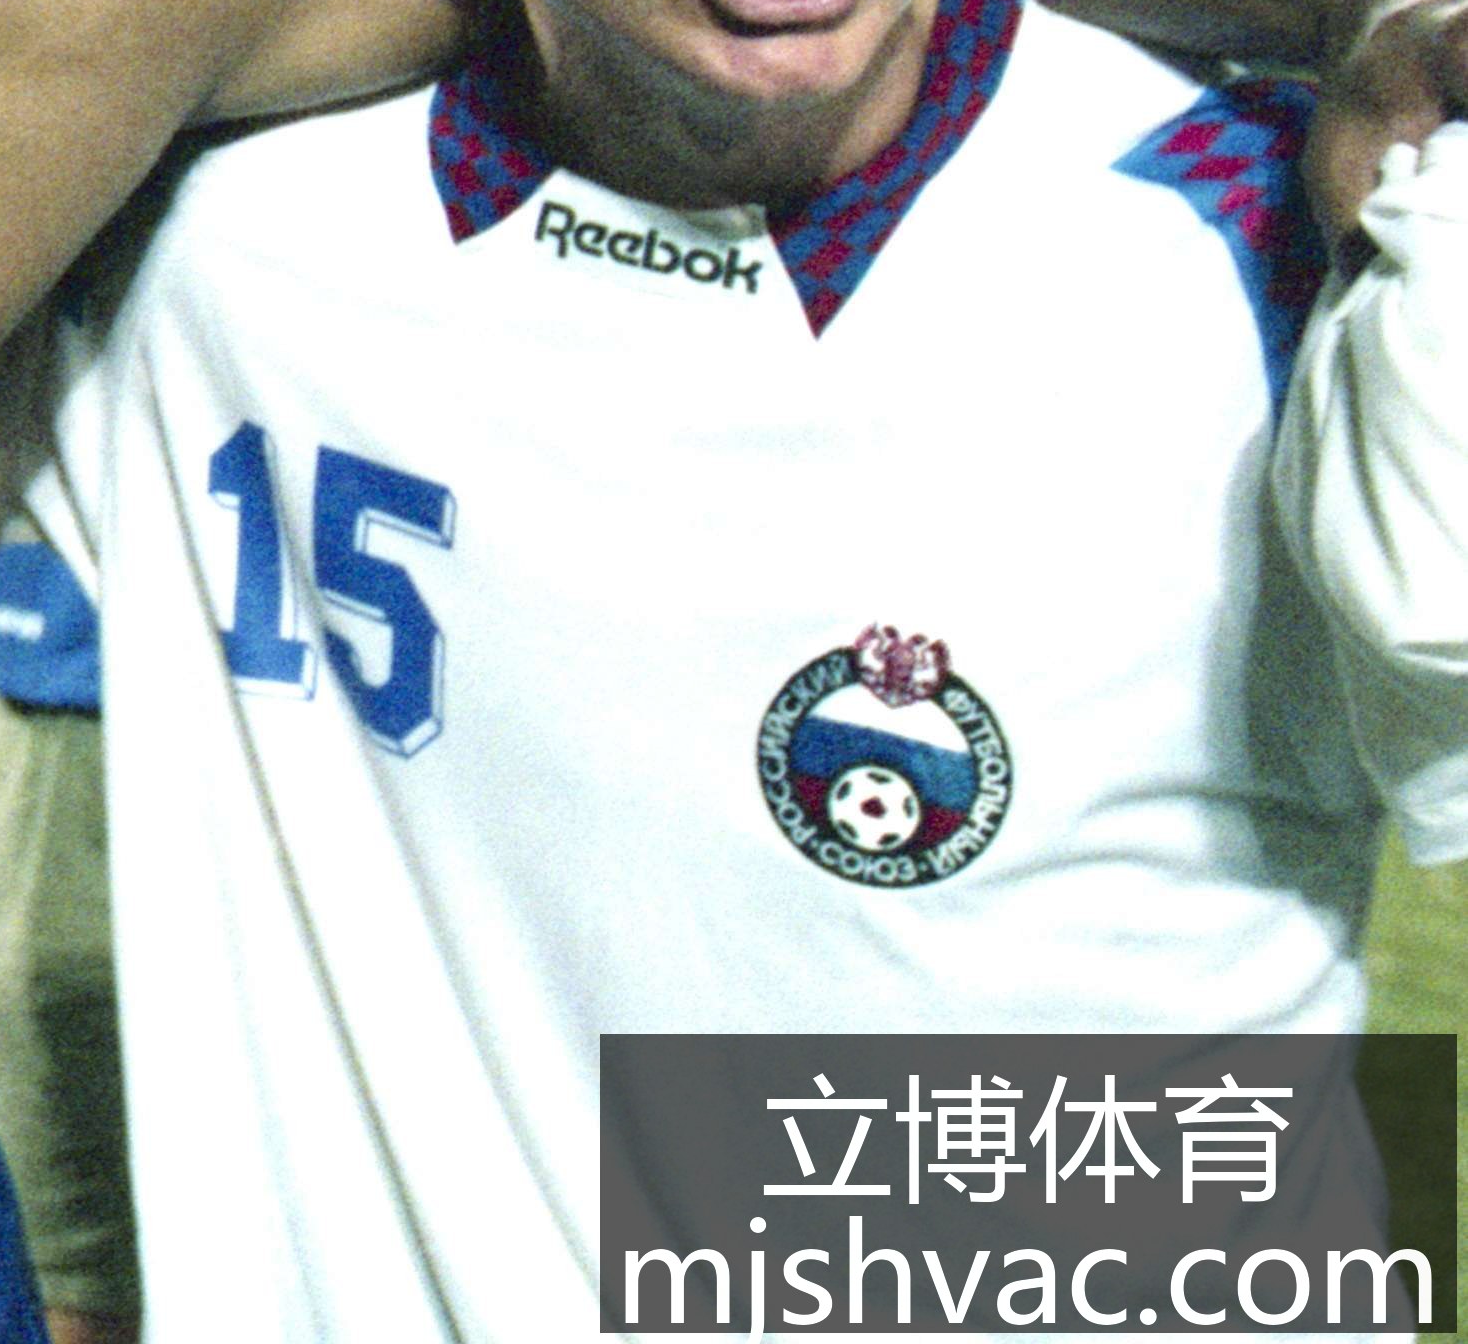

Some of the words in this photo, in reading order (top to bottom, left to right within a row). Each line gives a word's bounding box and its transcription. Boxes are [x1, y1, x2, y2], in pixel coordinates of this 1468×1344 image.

[534, 199, 763, 295] Reebok
[207, 418, 458, 759] 15
[927, 687, 1009, 875] ФУТБОЛЬНЫЙ
[817, 840, 918, 883] СОЮЗ
